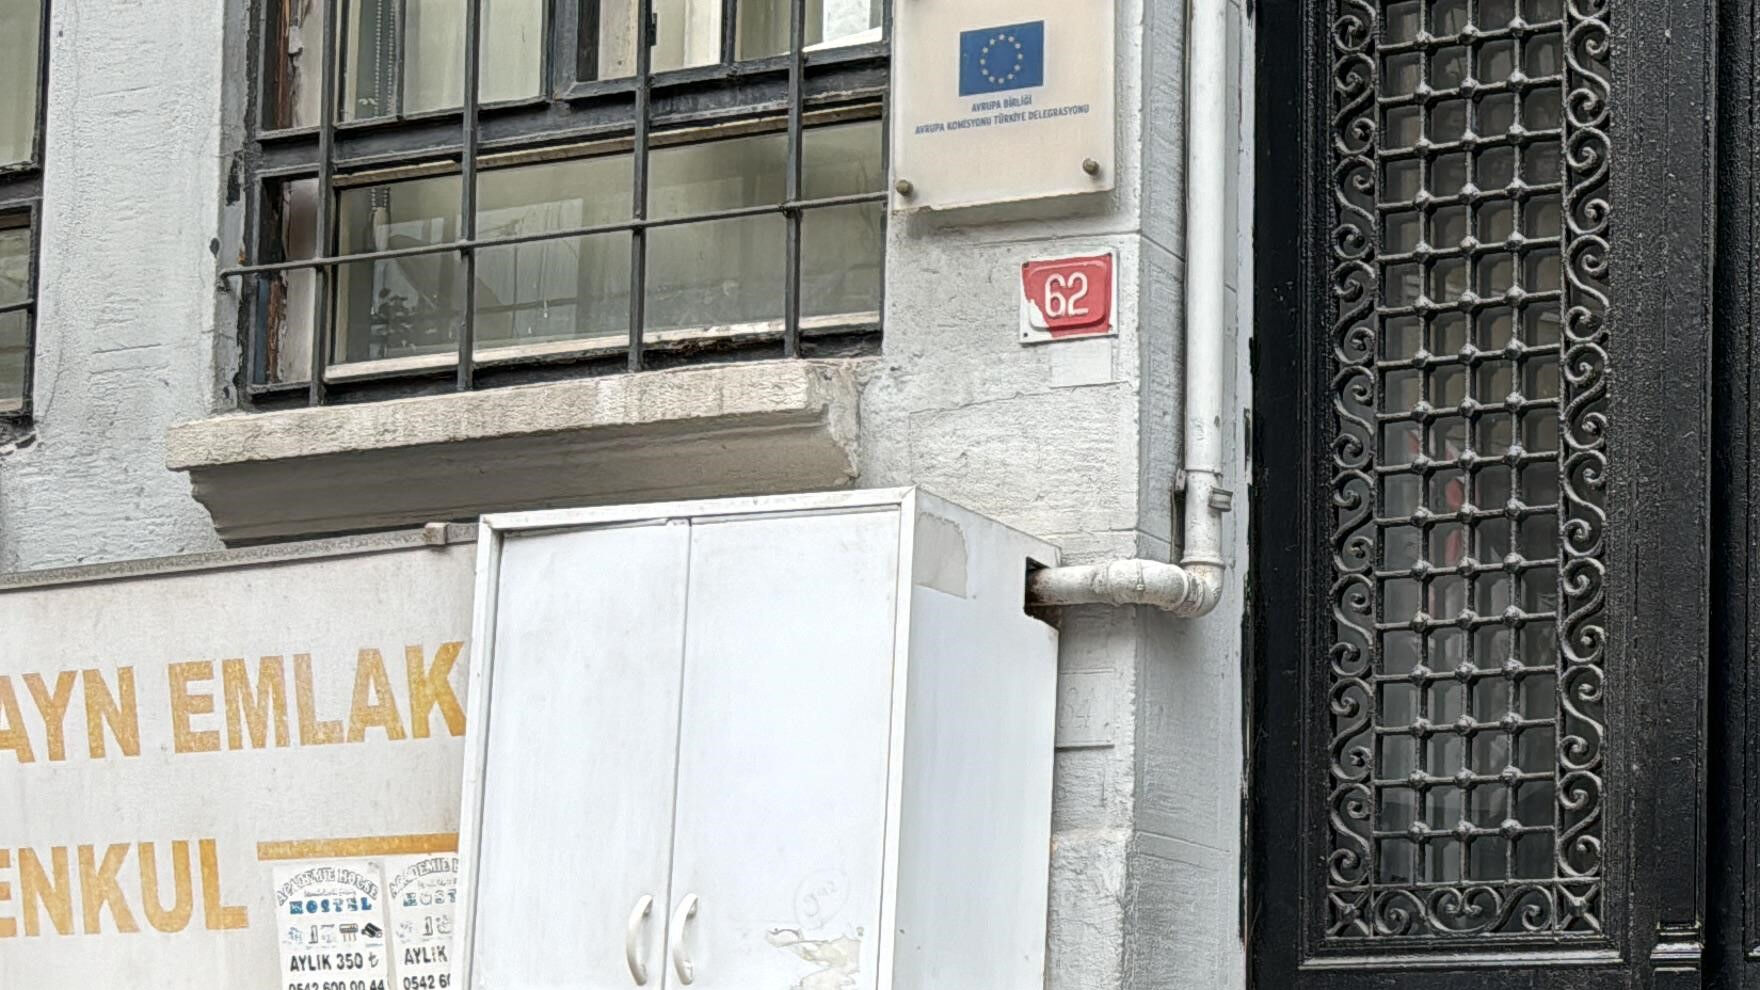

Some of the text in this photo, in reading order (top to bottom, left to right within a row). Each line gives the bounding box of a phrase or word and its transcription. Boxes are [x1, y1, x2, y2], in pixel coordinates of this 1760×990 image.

[971, 100, 1001, 112] AVRUPA
[915, 123, 945, 135] AVRUPA
[1044, 271, 1089, 318] 62
[168, 641, 467, 755] EMLAK
[289, 896, 372, 915] HOSTEL
[290, 954, 332, 972] AYLIK
[336, 952, 364, 970] 350
[404, 945, 448, 966] AYLIK
